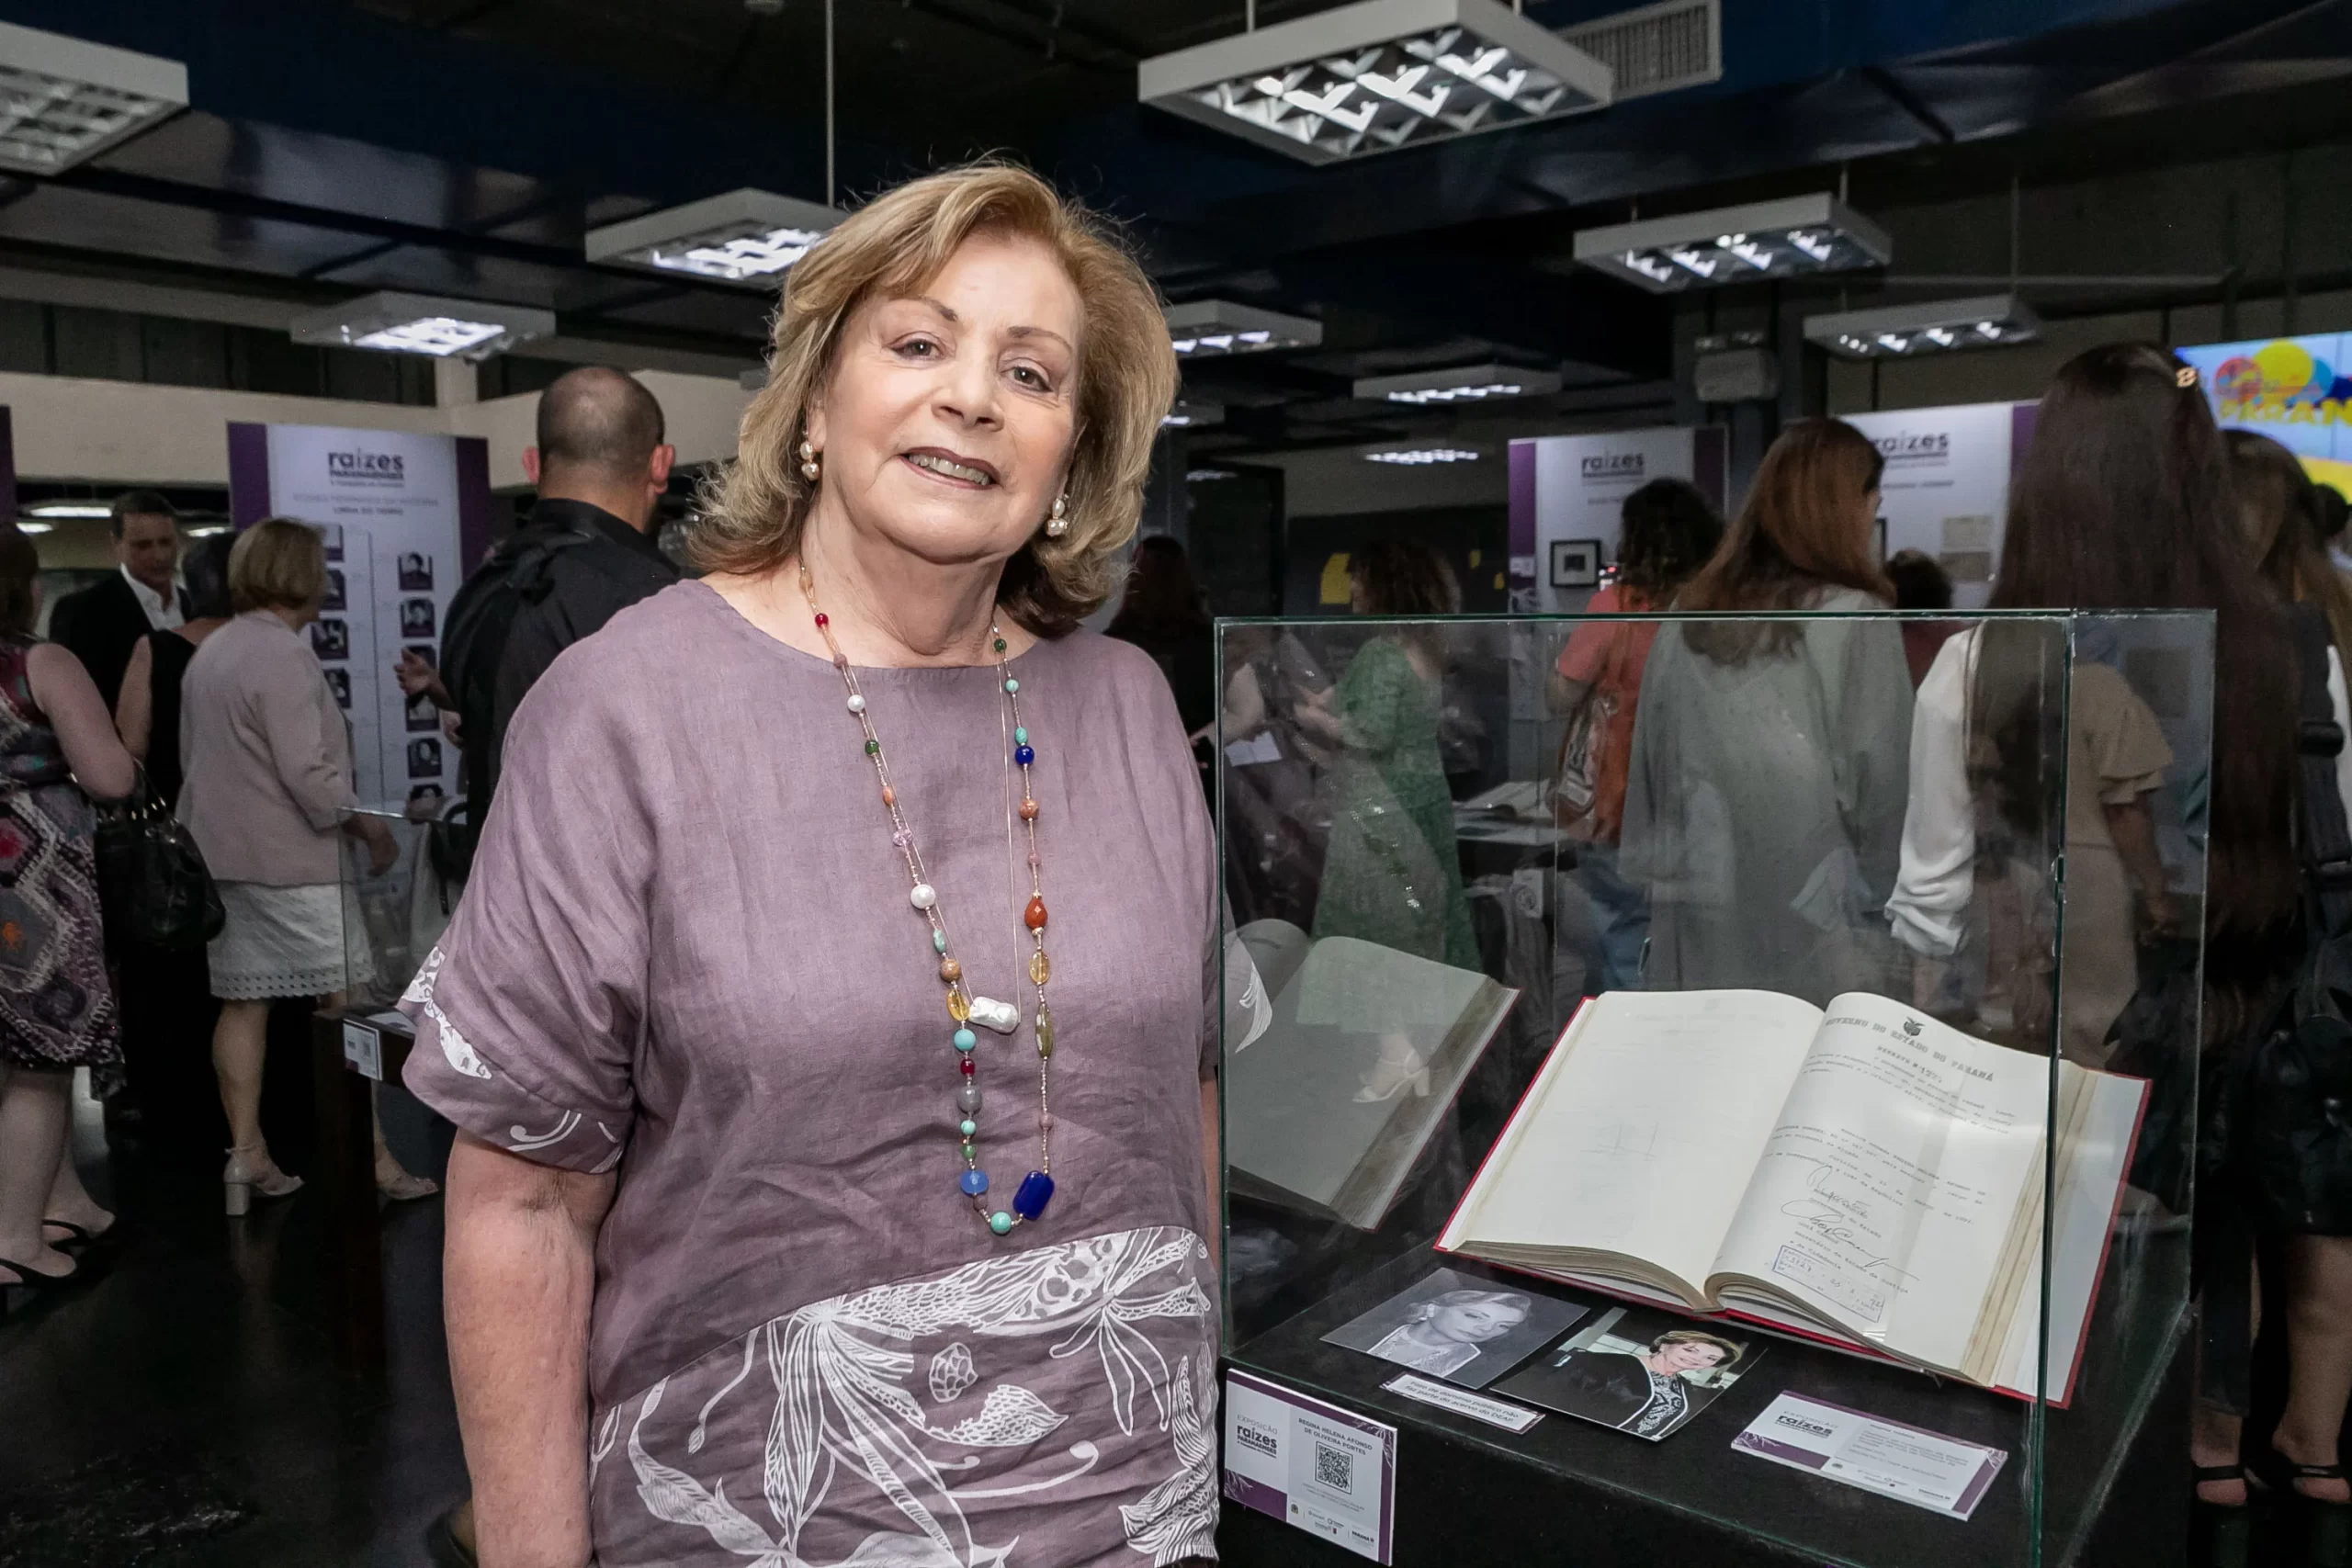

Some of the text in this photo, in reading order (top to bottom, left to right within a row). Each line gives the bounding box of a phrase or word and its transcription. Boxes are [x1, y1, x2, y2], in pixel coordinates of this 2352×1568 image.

[1237, 1425, 1277, 1449] raízes
[1298, 1417, 1373, 1451] REGINA HELENA AFONSO
[1304, 1427, 1366, 1456] DE OLIVEIRA PORTES
